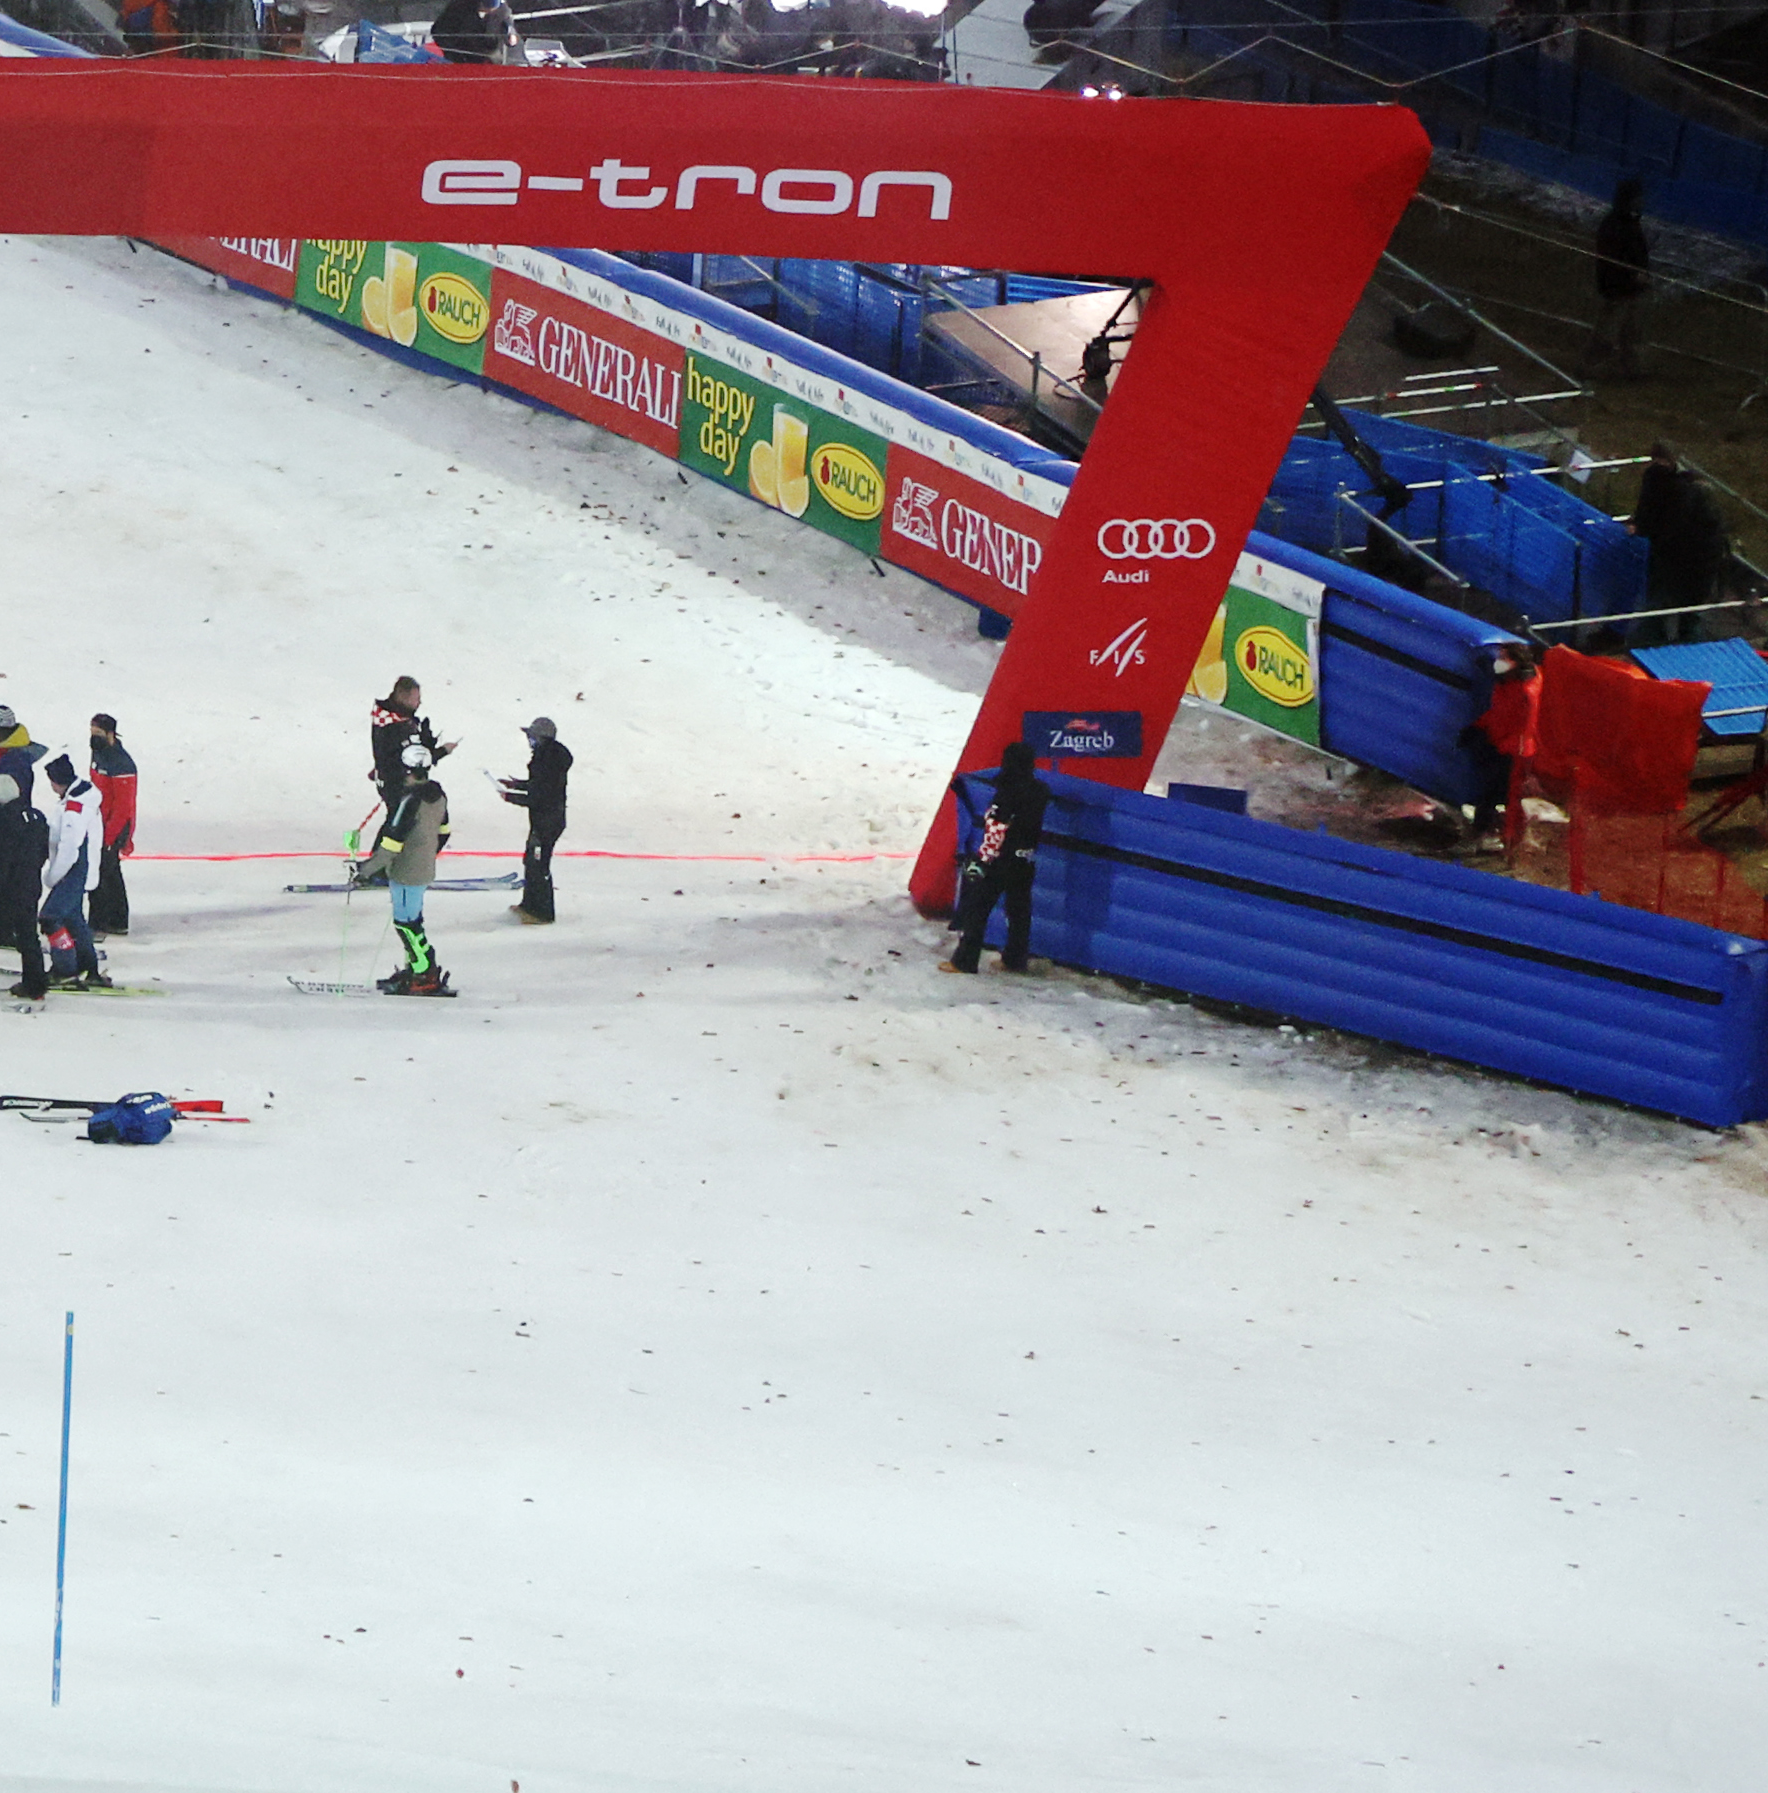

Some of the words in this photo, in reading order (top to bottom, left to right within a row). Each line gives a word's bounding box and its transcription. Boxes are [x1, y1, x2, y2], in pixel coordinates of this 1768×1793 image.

[421, 156, 954, 221] e-tron
[315, 255, 354, 314] day
[437, 291, 480, 329] RAUCH
[537, 315, 683, 429] GENERALI
[687, 356, 755, 436] happy
[699, 413, 742, 476] day
[829, 461, 878, 506] RAUCH
[941, 498, 1043, 596] GENER
[1102, 568, 1150, 583] Audi
[1256, 644, 1306, 691] RAUCH
[1049, 727, 1115, 753] Zagreb
